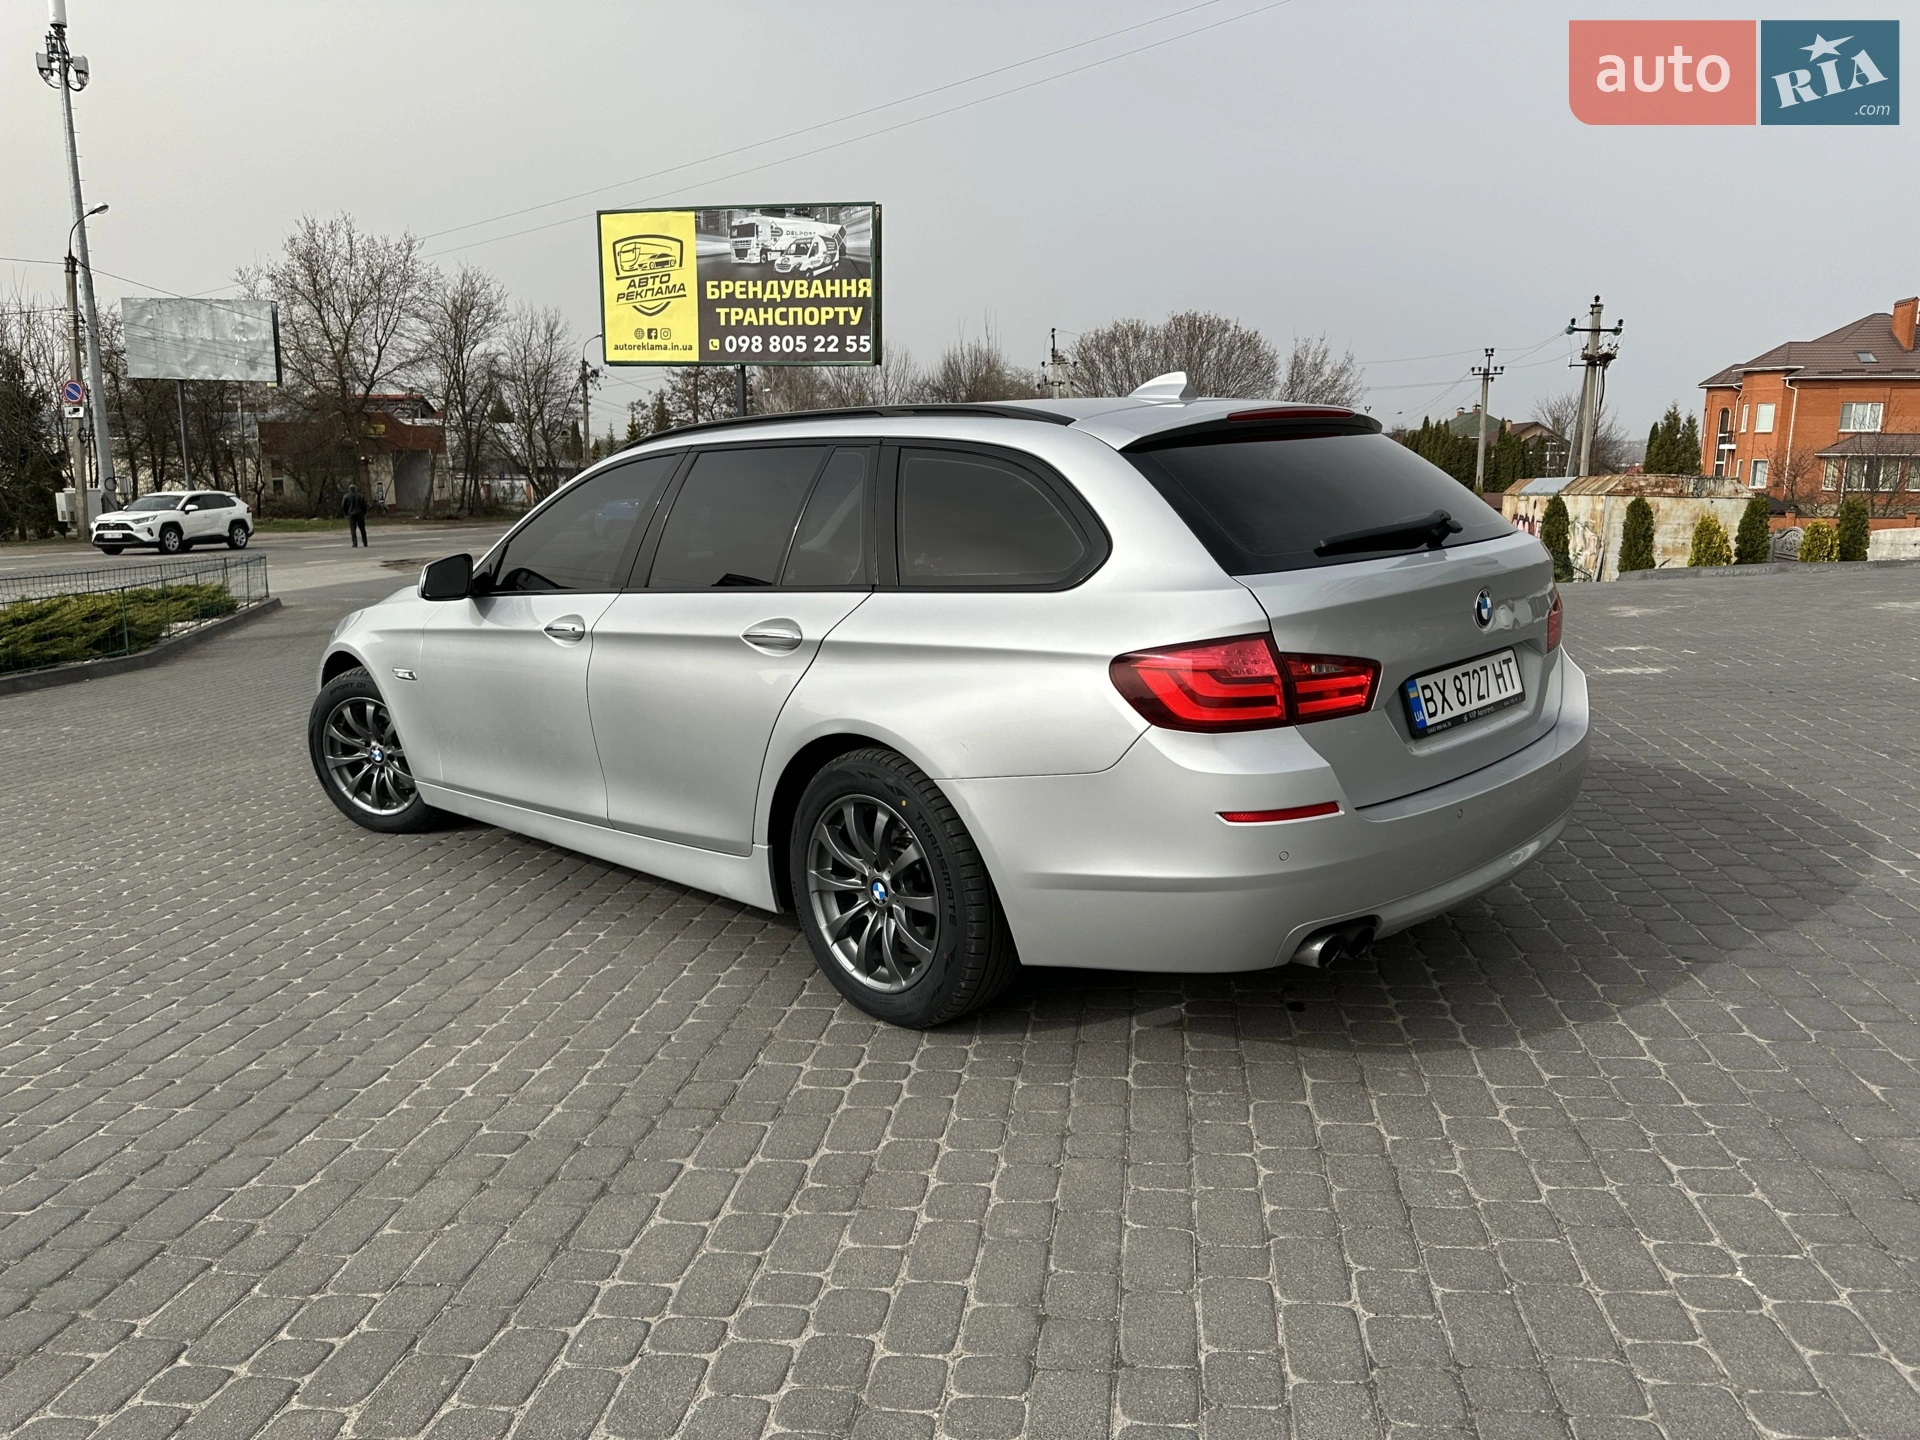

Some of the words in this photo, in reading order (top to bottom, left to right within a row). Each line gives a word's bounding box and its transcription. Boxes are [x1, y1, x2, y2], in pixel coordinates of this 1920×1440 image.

[626, 273, 671, 290] АВТО
[706, 278, 872, 303] БРЕНДУВАННЯ
[616, 283, 686, 303] РЕКЛАМА
[715, 306, 864, 326] ТРАНСПОРТУ
[613, 342, 693, 351] autoreklama.in.ua
[724, 335, 763, 353] 098
[769, 335, 807, 353] 805
[813, 335, 839, 353] 22
[845, 335, 871, 353] 55
[1453, 665, 1490, 707] 8727
[1414, 710, 1425, 722] UA
[915, 810, 958, 927] TRANSMATE
